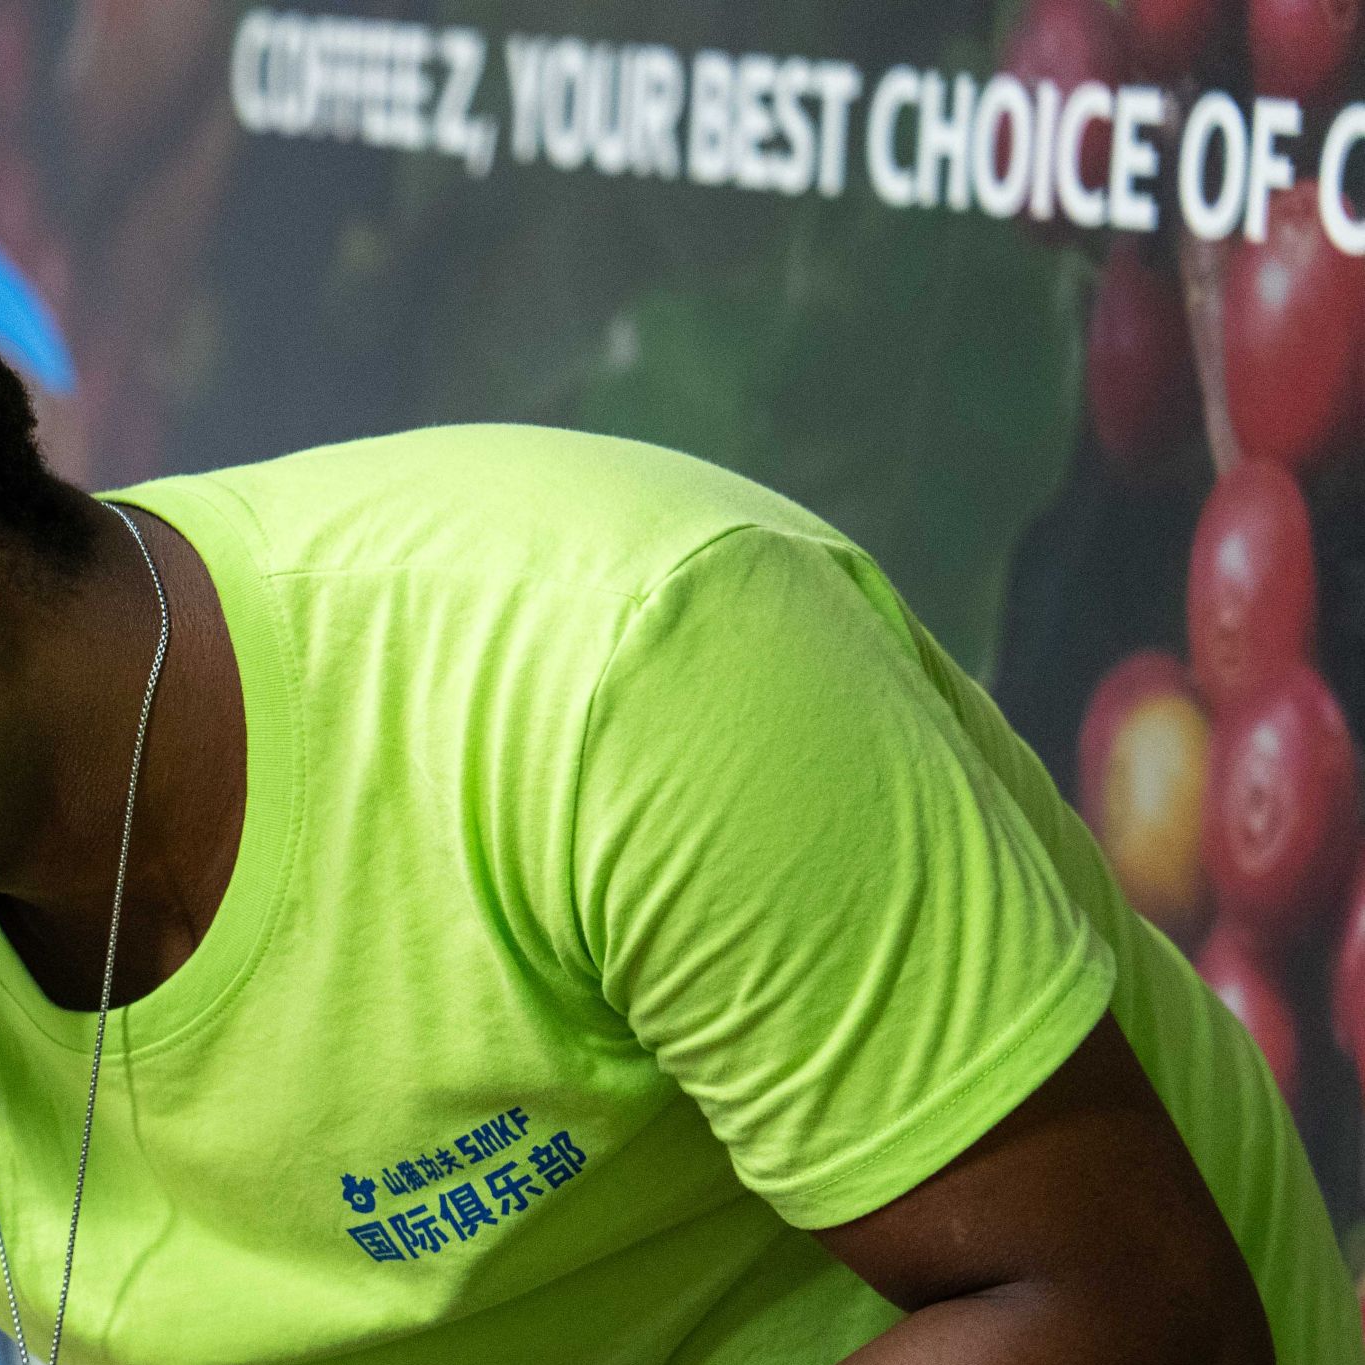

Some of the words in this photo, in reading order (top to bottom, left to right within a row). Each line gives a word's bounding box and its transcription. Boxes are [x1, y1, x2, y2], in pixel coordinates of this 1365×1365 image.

[506, 36, 685, 178] YOUR
[688, 50, 862, 197] BEST
[868, 66, 1163, 231] CHOICE
[1179, 92, 1303, 243] OF
[346, 1130, 587, 1262] 国际俱乐部
[454, 1106, 530, 1164] SMKF
